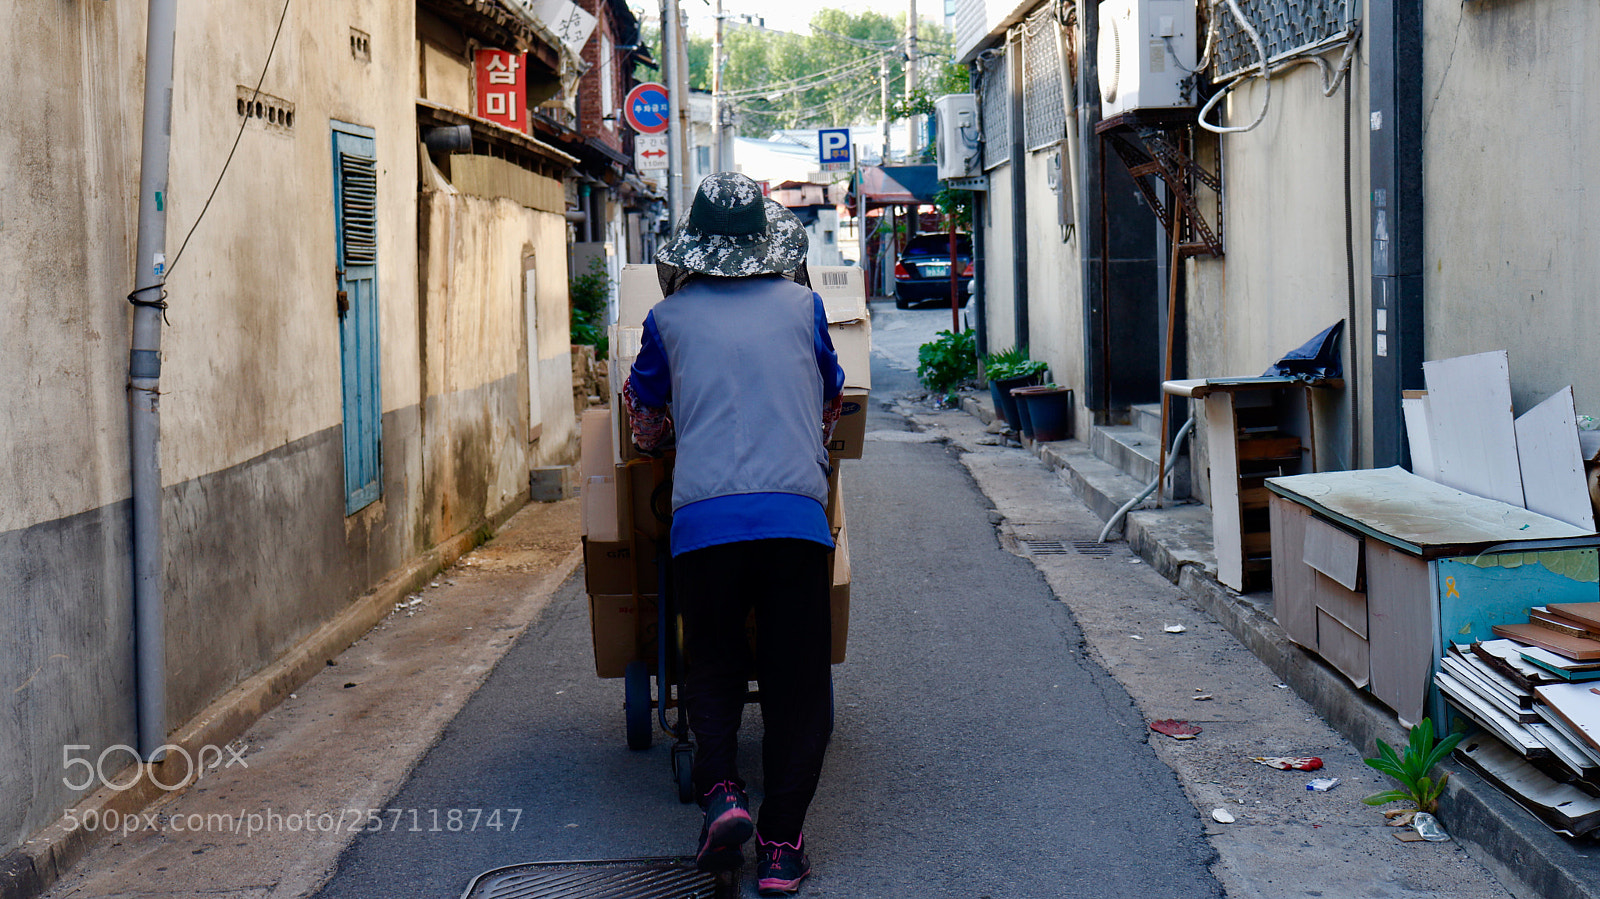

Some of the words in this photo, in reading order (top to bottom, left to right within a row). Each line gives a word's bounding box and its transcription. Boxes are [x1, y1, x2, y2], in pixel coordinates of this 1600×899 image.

[486, 54, 520, 121] 삼미
[634, 103, 668, 114] 주차금지
[822, 133, 847, 160] P
